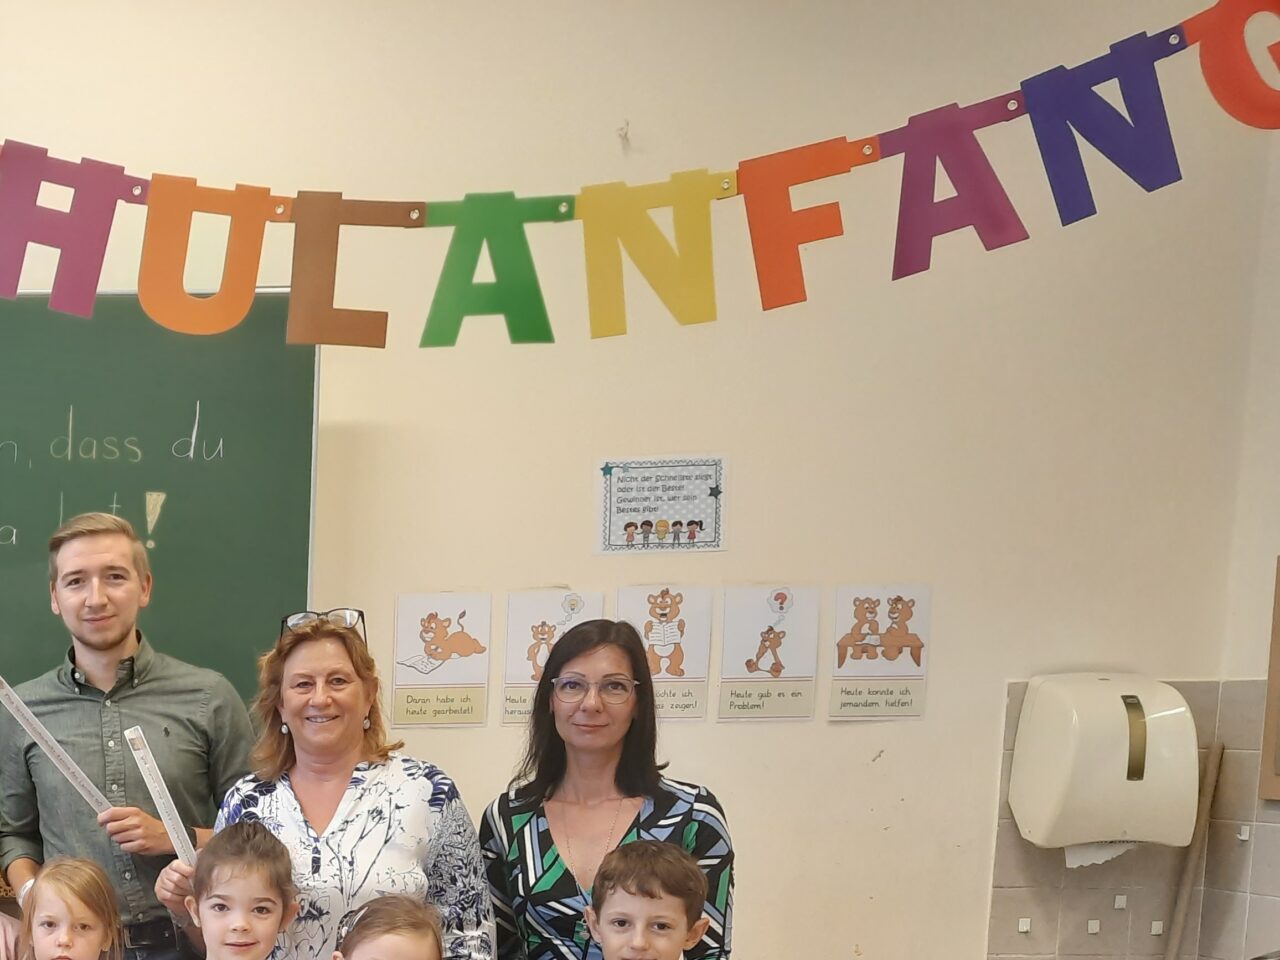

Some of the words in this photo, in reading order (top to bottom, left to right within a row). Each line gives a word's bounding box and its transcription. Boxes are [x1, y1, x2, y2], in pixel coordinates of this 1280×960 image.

[49, 404, 142, 462] dass
[171, 400, 224, 461] du
[655, 688, 677, 698] öchte
[681, 688, 694, 697] ich
[730, 688, 753, 698] Heute
[757, 688, 772, 700] gab
[790, 690, 802, 698] ein
[840, 686, 863, 696] Heute
[867, 686, 894, 696] konnte
[899, 686, 911, 696] ich
[406, 695, 431, 704] Daran
[436, 694, 455, 703] habe
[460, 695, 471, 703] ich
[884, 698, 913, 708] helfen!
[729, 700, 765, 710] Problem!
[405, 707, 427, 715] heute
